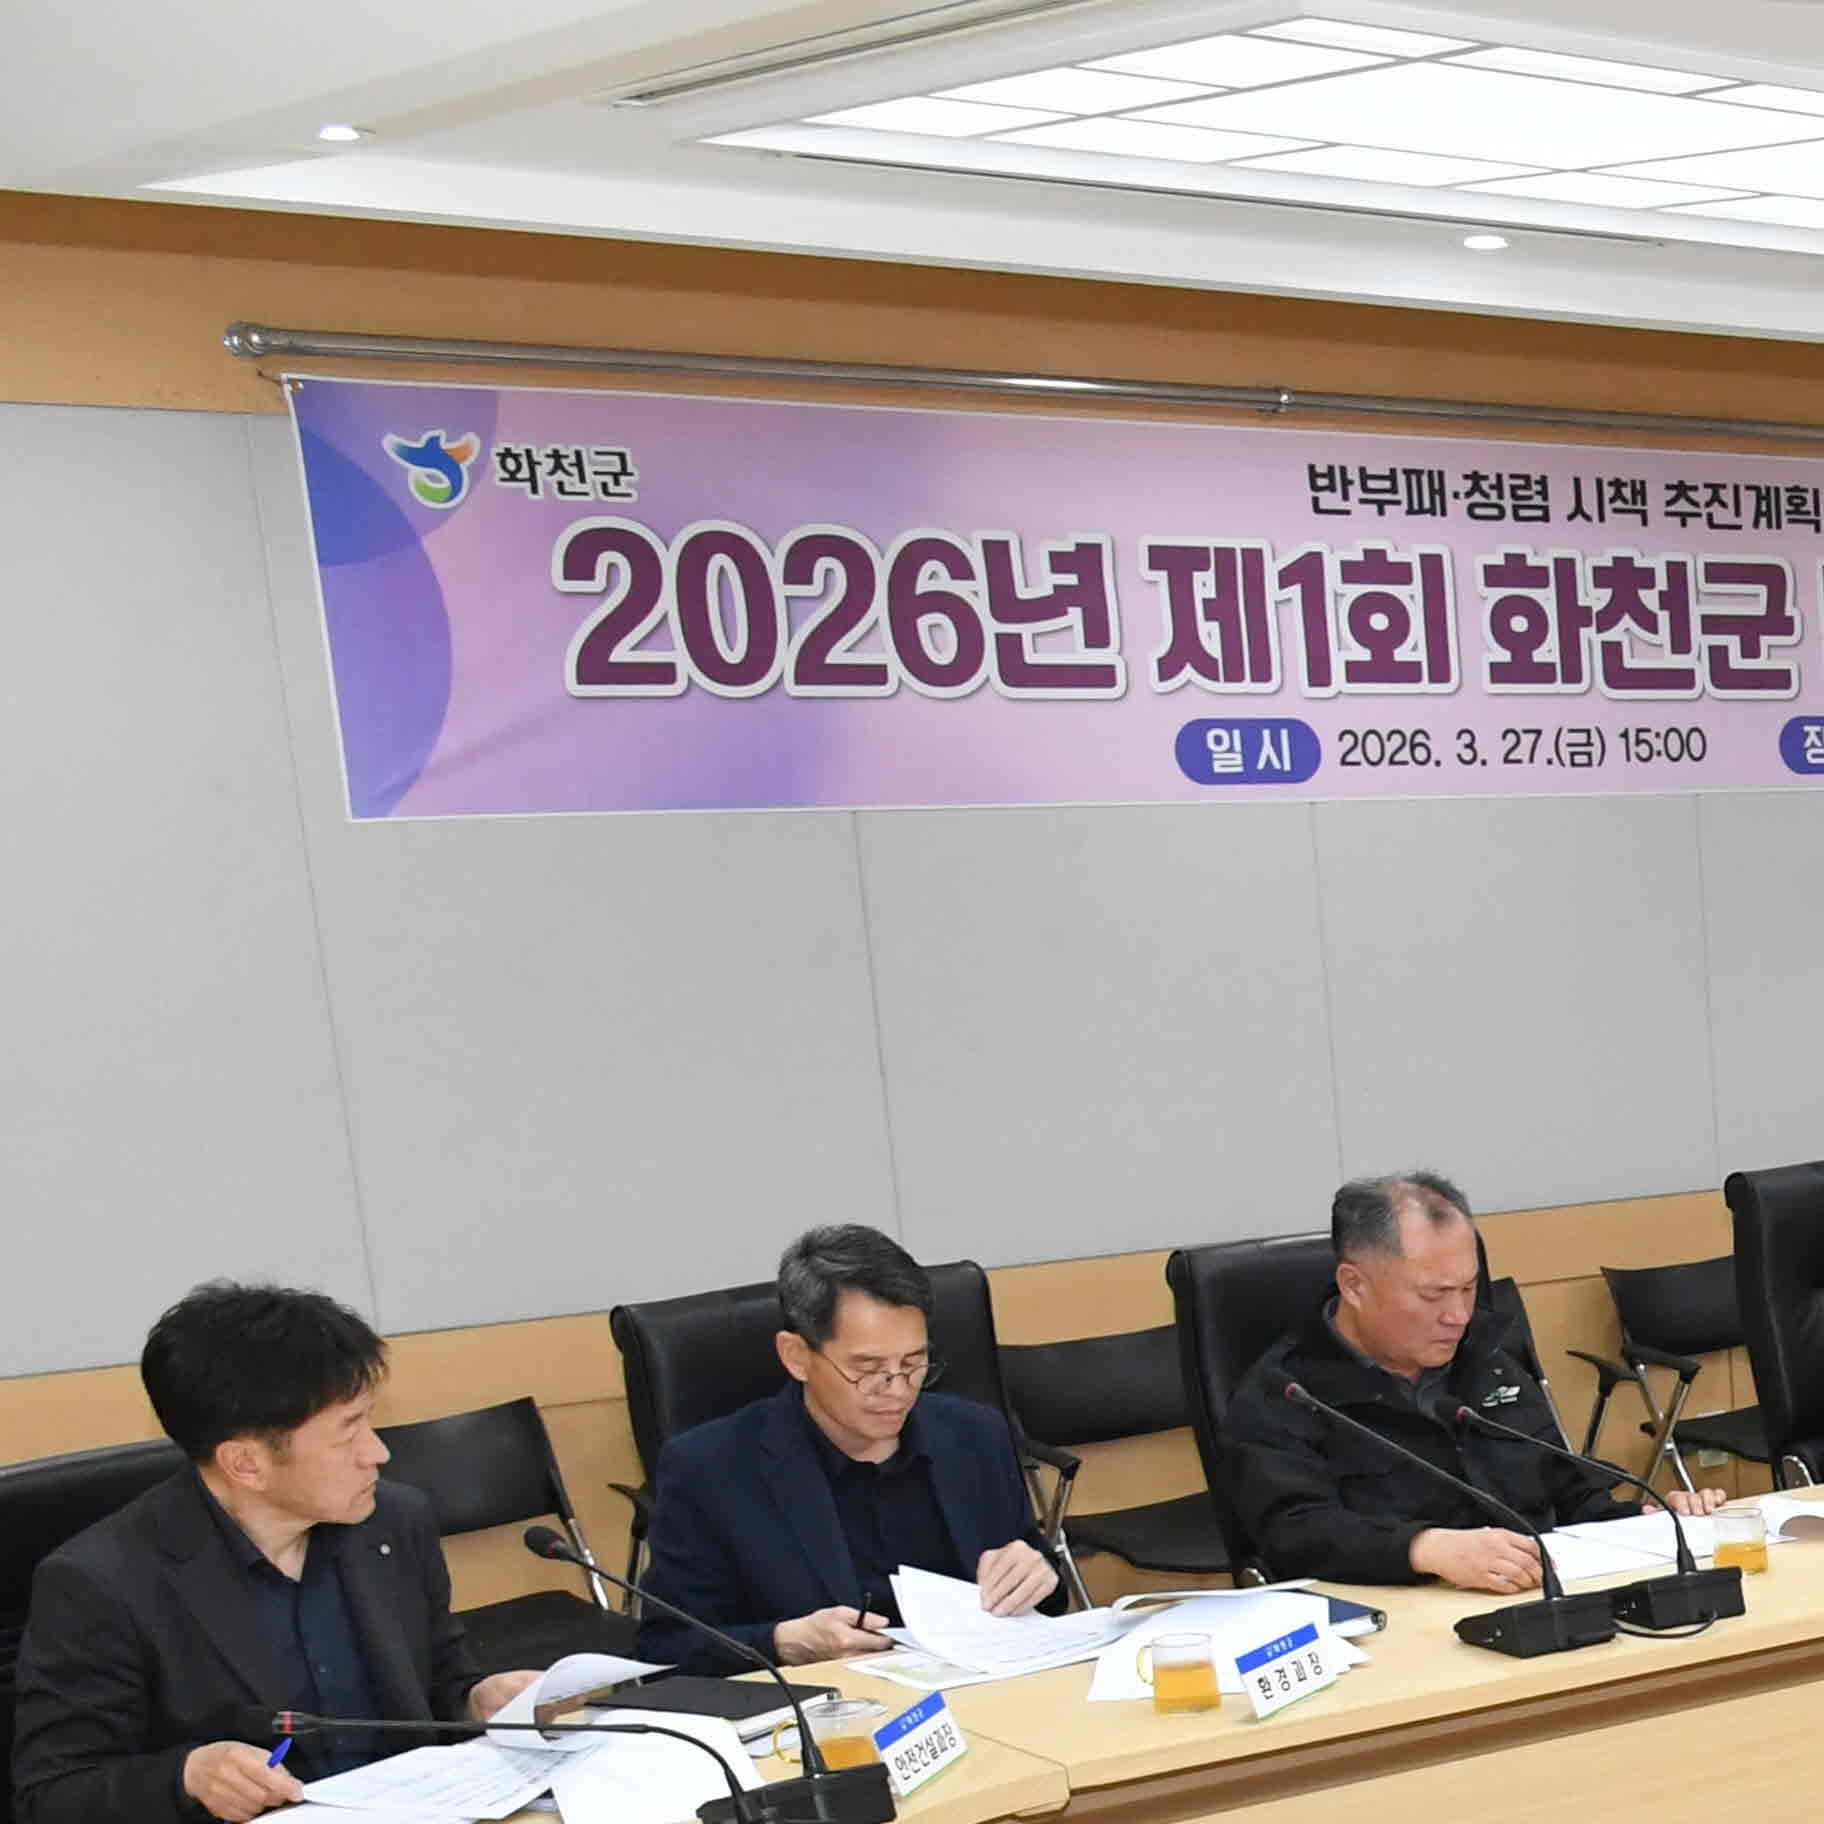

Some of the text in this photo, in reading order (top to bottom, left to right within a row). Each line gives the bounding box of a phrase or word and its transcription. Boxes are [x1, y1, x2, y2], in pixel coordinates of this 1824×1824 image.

[495, 447, 635, 498] 화천군
[1308, 463, 1551, 523] 반부패·청렴
[1566, 476, 1649, 527] 시책
[1663, 479, 1822, 534] 추진계획
[563, 527, 1116, 688] 2026년
[1148, 545, 1450, 687] 제1회
[1483, 553, 1796, 690] 화천군
[1338, 729, 1442, 767] 2026.
[1457, 729, 1488, 766] 3.
[1502, 727, 1607, 768] 27.(금)
[1619, 727, 1707, 763] 15:00
[893, 1722, 958, 1781] 안전건설과장
